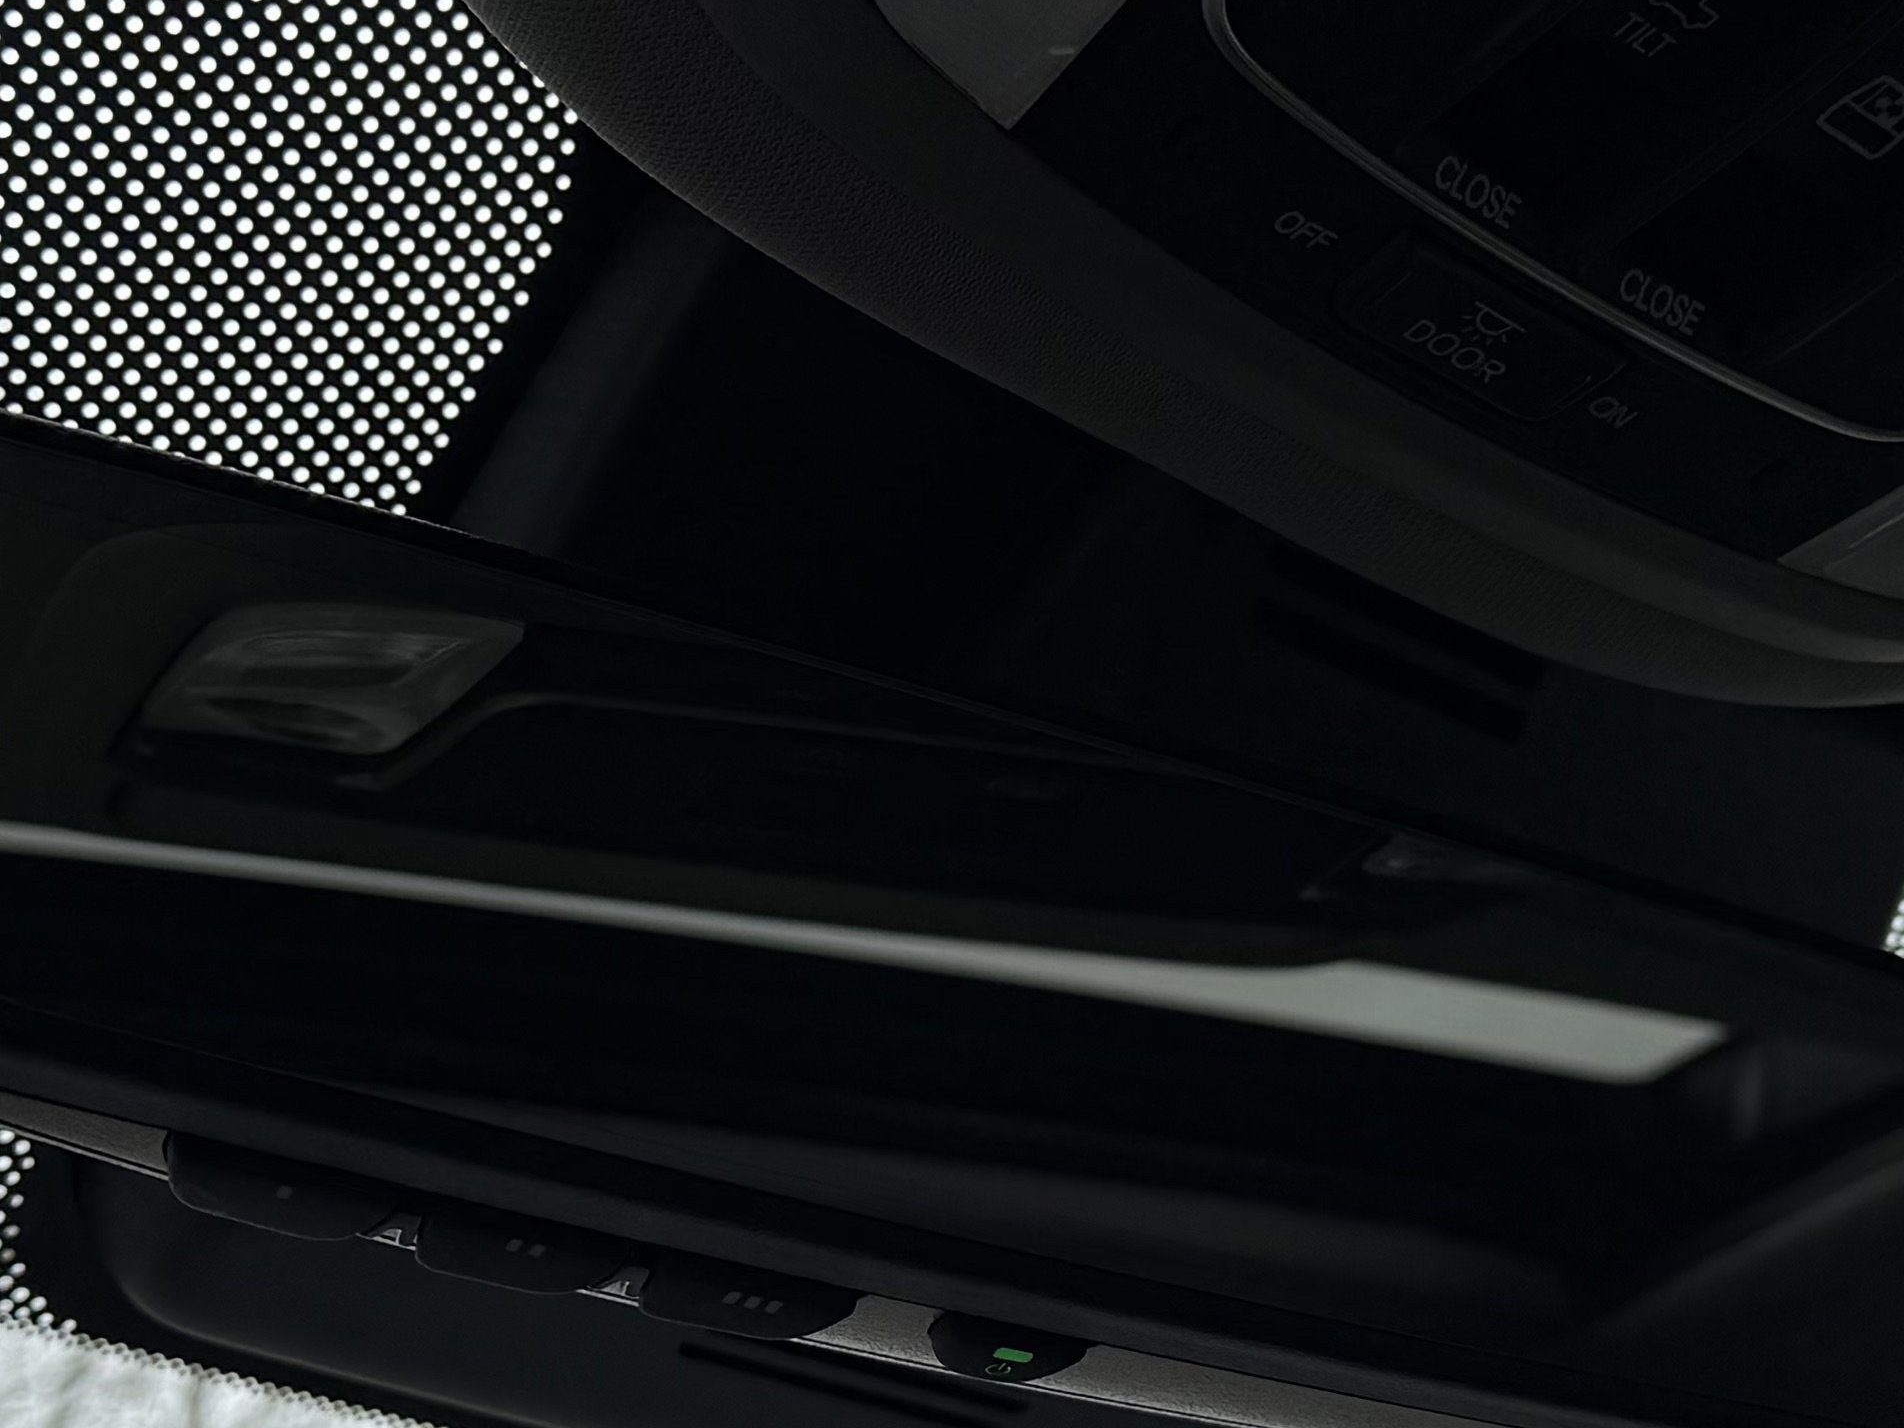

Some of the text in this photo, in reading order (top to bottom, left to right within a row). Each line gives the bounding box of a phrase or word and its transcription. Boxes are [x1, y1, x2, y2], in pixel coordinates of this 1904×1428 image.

[1611, 11, 1678, 58] TILT
[1433, 154, 1522, 229] CLOSE
[1274, 210, 1338, 249] OFF
[1618, 267, 1703, 336] CLOSE
[1403, 317, 1506, 383] DOOR
[1588, 395, 1637, 432] ON
